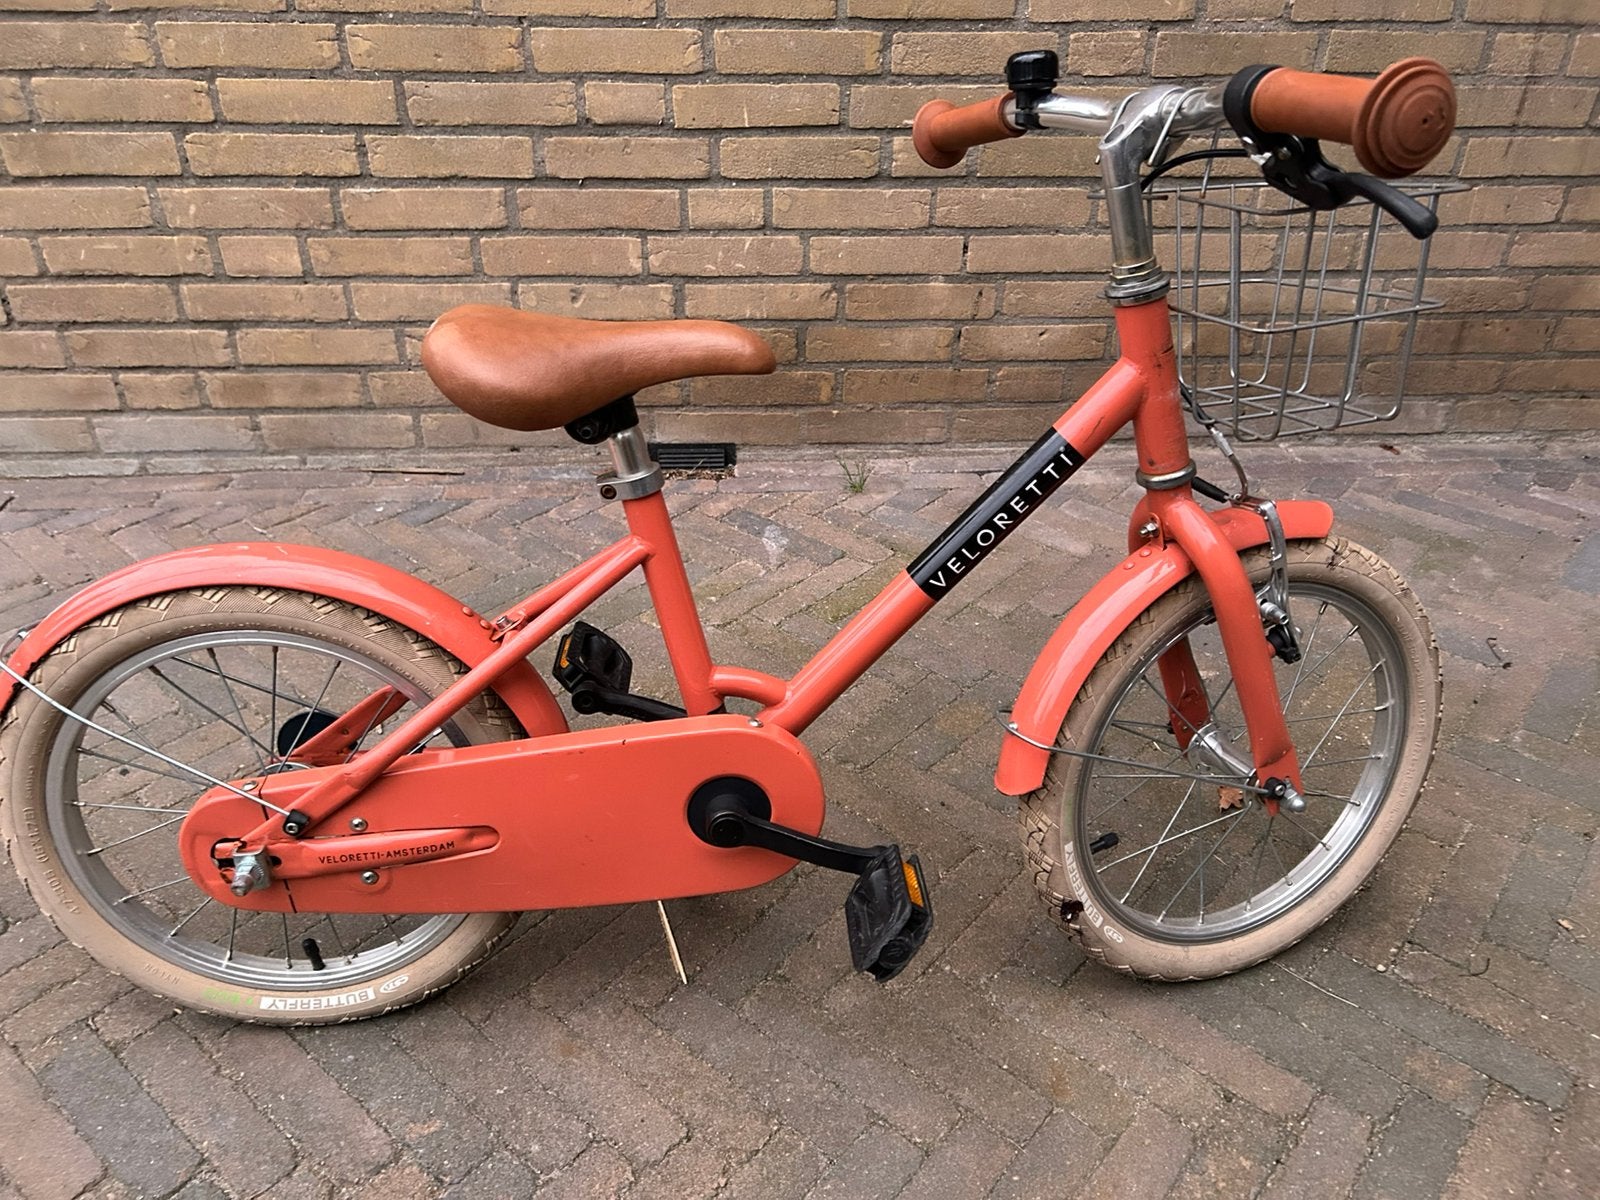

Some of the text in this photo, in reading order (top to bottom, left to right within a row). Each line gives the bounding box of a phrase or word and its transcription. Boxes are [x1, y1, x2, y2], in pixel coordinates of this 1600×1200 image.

[929, 453, 1074, 588] VELORETTI
[318, 841, 455, 864] VELORETTI-AMSTERDAM
[1065, 849, 1101, 924] BUTTERFLY
[267, 990, 370, 1010] BUTTERFLY
